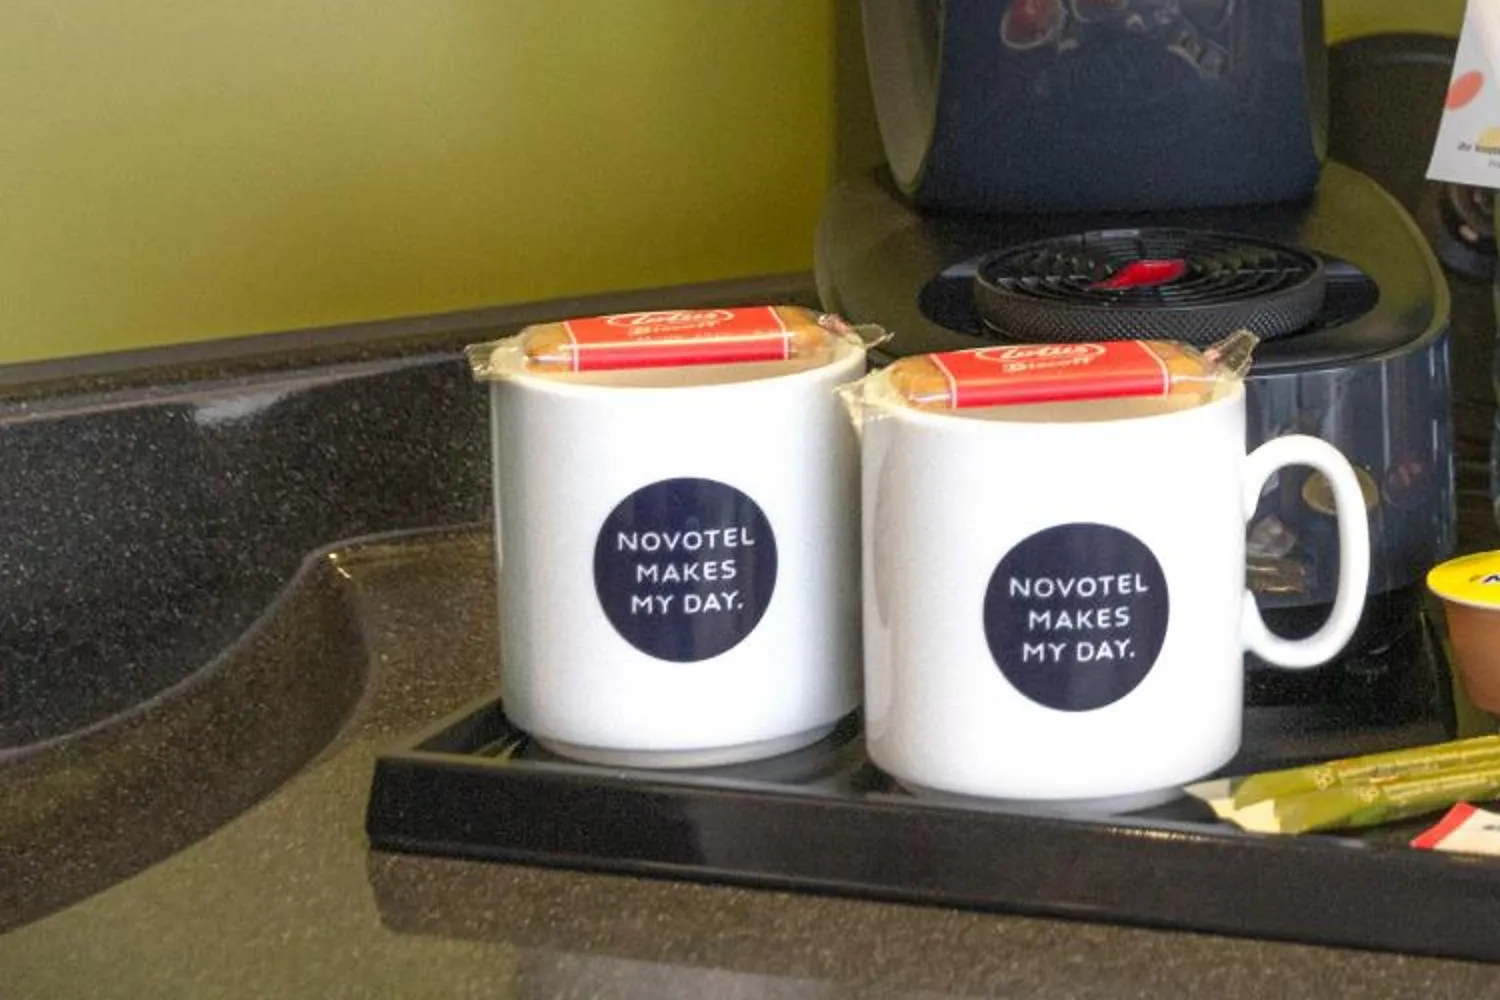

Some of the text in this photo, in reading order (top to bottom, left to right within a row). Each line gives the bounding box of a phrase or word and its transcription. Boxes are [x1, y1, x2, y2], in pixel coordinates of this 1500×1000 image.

[617, 527, 755, 550] NOVOTEL
[636, 560, 737, 583] MAKES
[1009, 573, 1149, 598] NOVOTEL
[631, 590, 743, 614] MY DAY.
[1028, 606, 1131, 630] MAKES
[1023, 638, 1136, 663] MY DAY.
